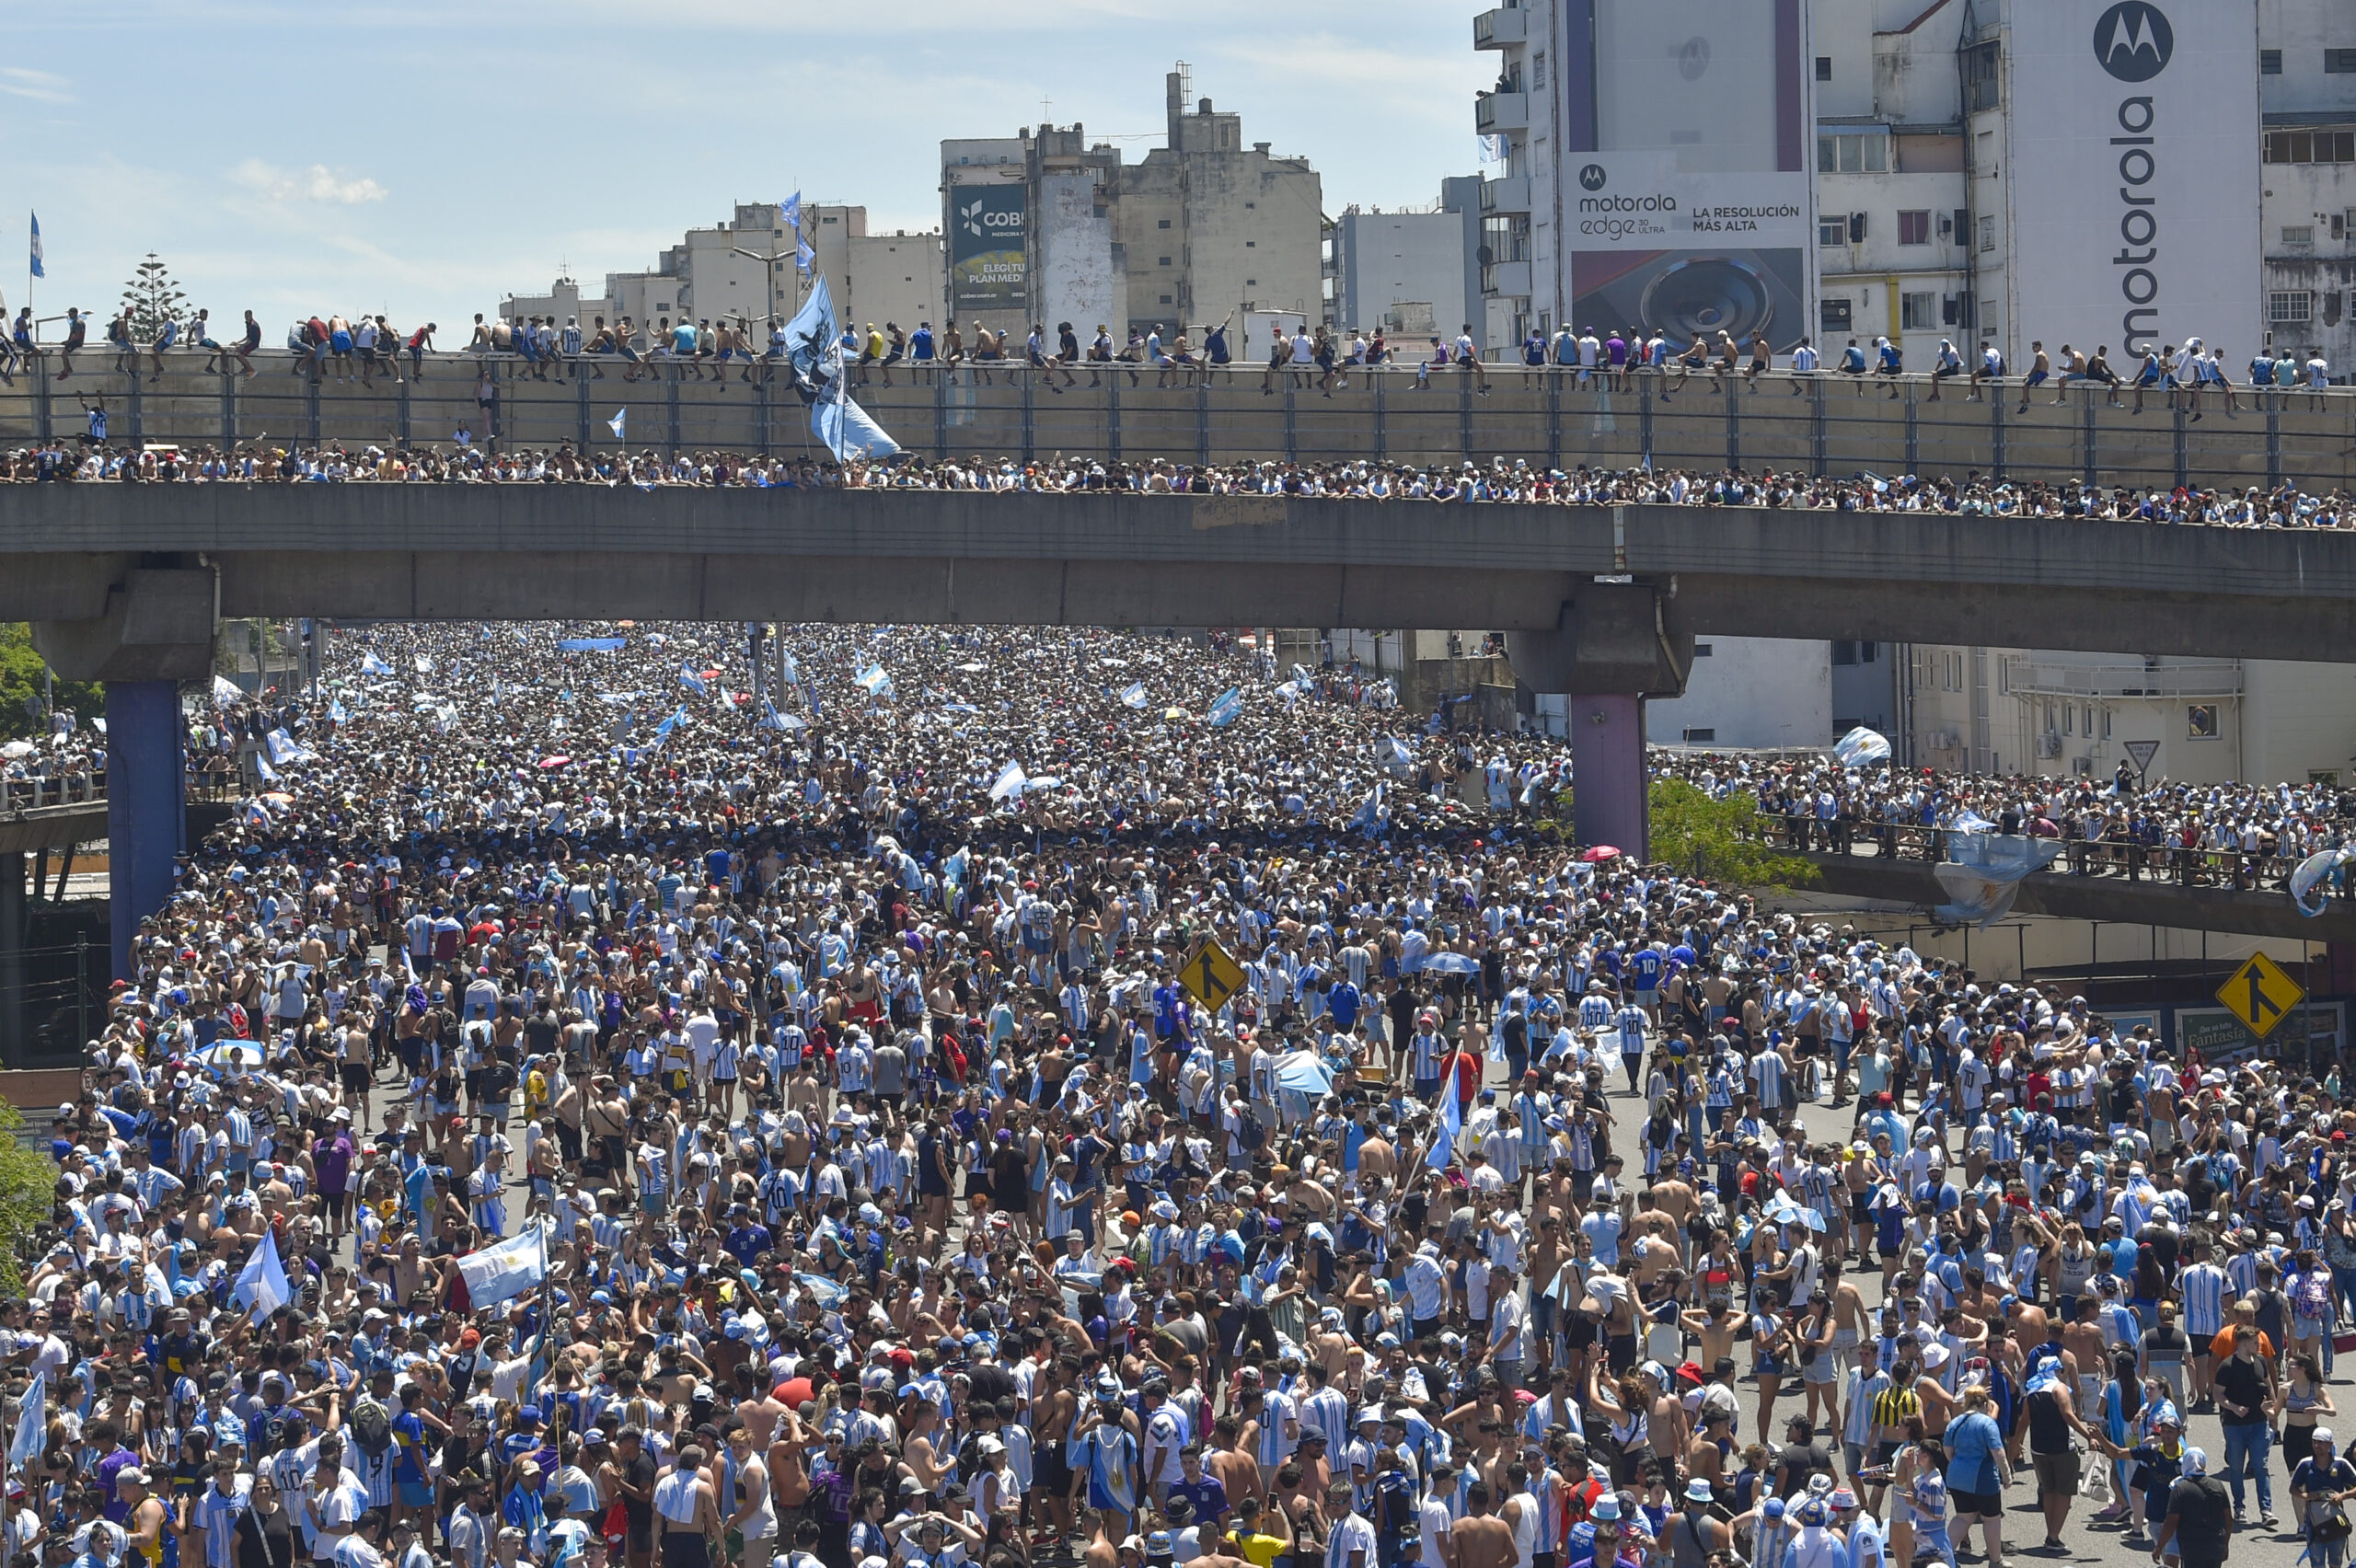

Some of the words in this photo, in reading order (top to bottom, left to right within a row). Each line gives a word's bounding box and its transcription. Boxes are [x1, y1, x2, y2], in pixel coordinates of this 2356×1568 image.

[1579, 194, 1677, 213] motorola
[1693, 208, 1710, 218] LA
[1714, 203, 1799, 218] RESOLUCIÓN
[1580, 215, 1635, 241] edge
[1693, 219, 1721, 232] MÁS
[1725, 221, 1757, 231] ALTA
[2110, 96, 2159, 360] motorola
[983, 261, 1011, 272] ELEGÍ
[1012, 263, 1025, 271] TU
[969, 274, 997, 283] PLAN
[1532, 342, 1542, 353] 10
[2316, 366, 2327, 379] 10
[2073, 824, 2085, 833] 23
[1642, 959, 1657, 974] 10
[1140, 986, 1150, 1003] 10
[1588, 1011, 1602, 1026] 10
[1626, 1020, 1638, 1035] 10
[783, 1036, 799, 1050] 10
[2189, 1027, 2246, 1047] Fantasía
[840, 1061, 851, 1075] 10
[919, 1078, 928, 1091] 10
[1964, 1069, 1976, 1090] 10
[1807, 1178, 1824, 1198] 10
[740, 1241, 748, 1251] 10
[137, 1309, 147, 1319] 10
[1882, 1353, 1892, 1362] 10
[281, 1469, 303, 1491] 10
[1655, 1519, 1663, 1528] 10
